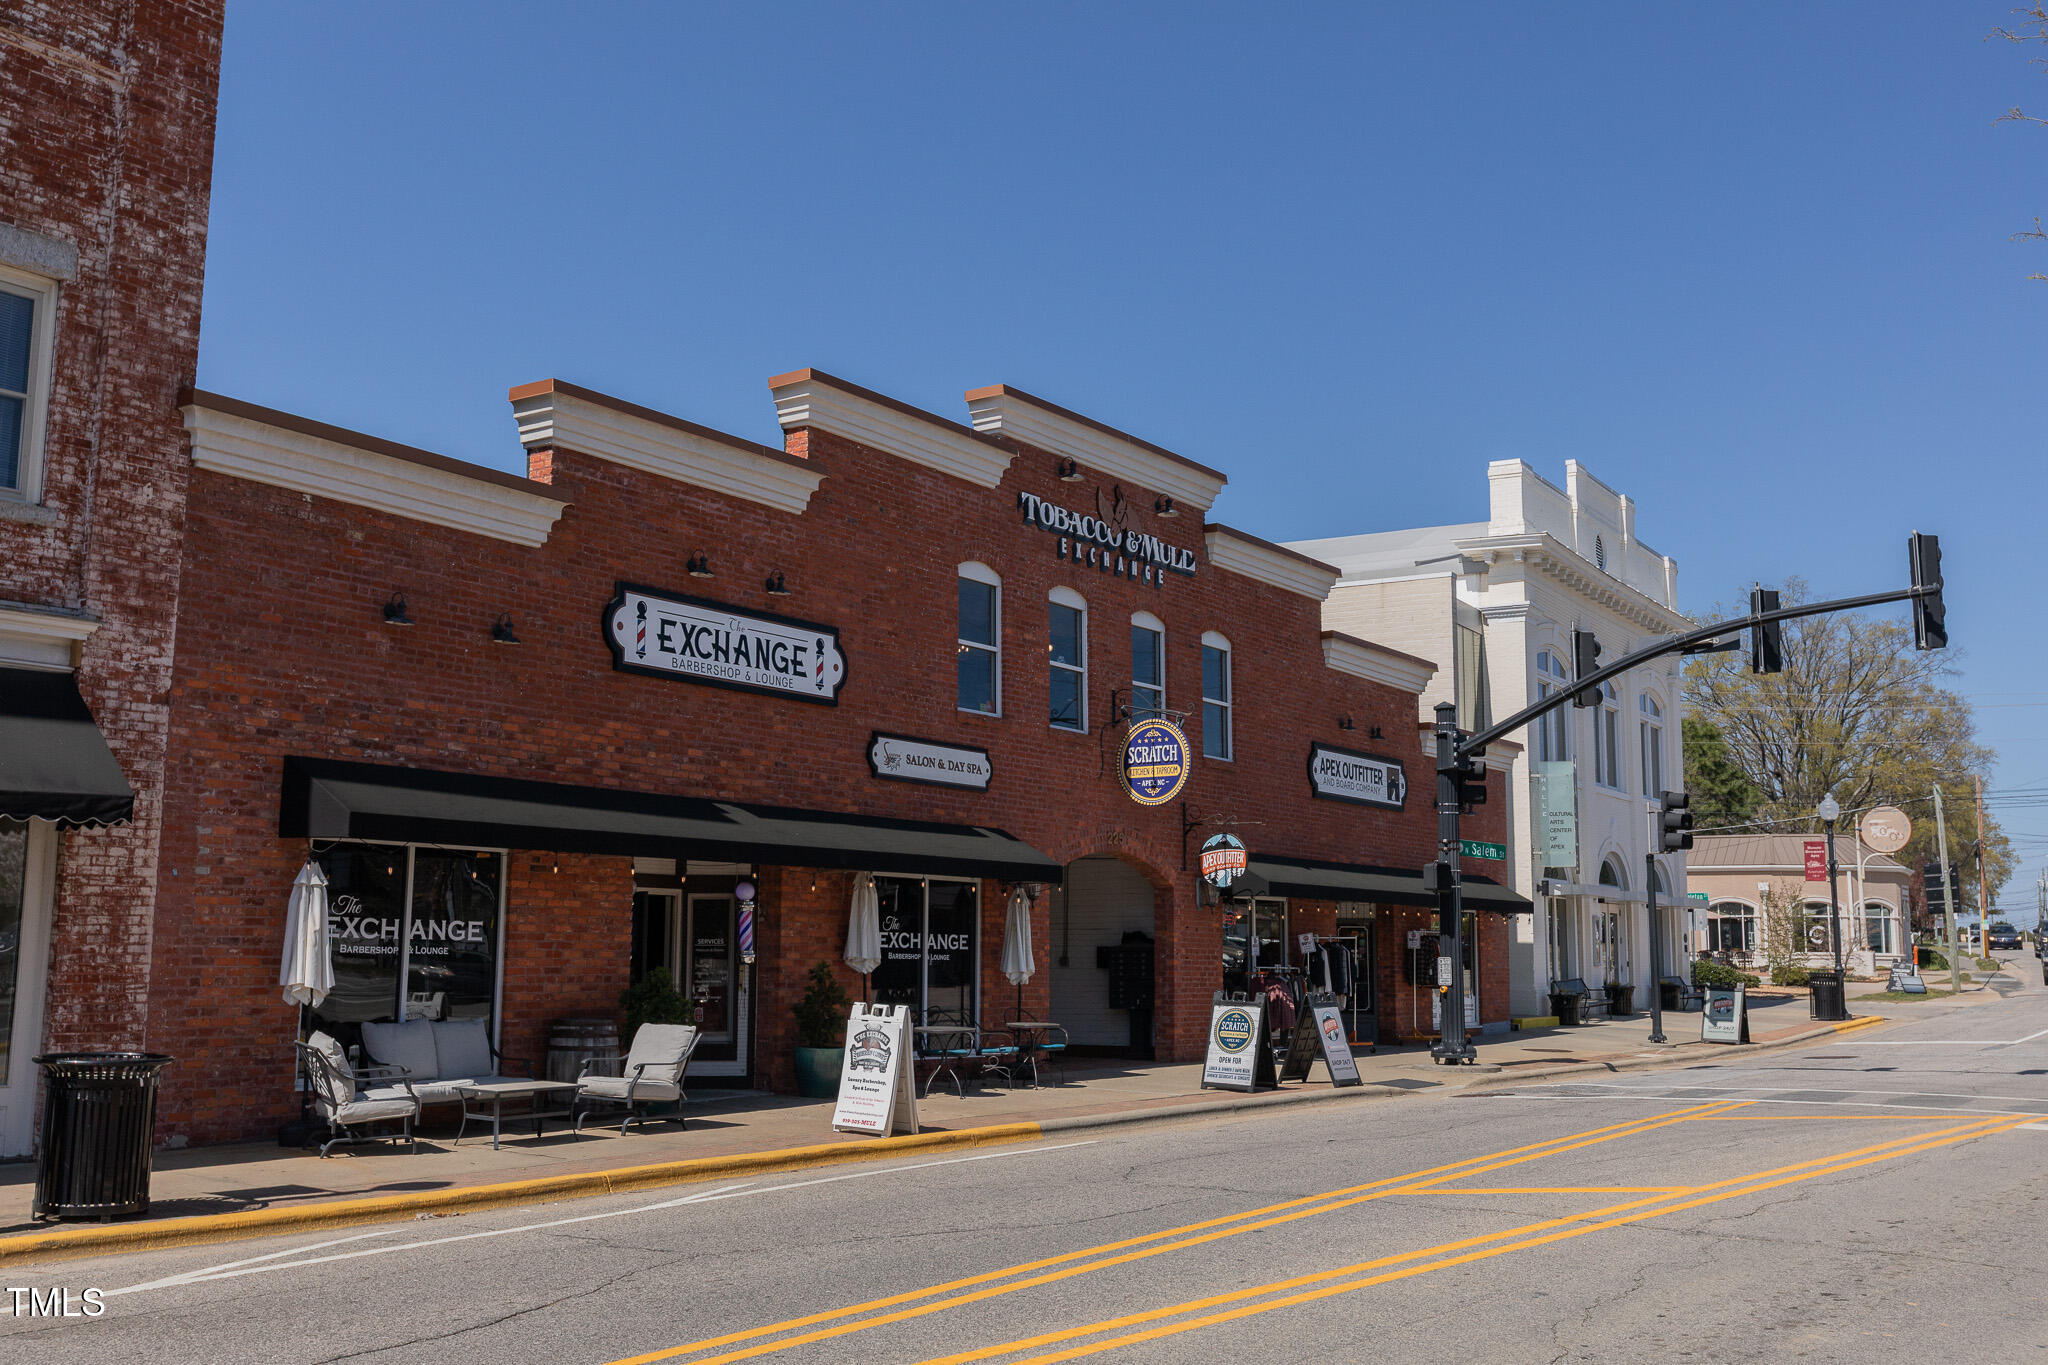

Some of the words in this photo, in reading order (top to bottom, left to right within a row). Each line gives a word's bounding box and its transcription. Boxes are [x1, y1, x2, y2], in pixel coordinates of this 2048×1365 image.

[1019, 491, 1122, 548] TOBACCO
[1126, 530, 1142, 552] &
[1141, 534, 1196, 572] MULE
[1058, 537, 1164, 584] EXCHANGE
[728, 617, 746, 633] The
[656, 618, 808, 678] EXCHANGE
[672, 657, 740, 679] BARBERSHOP
[744, 671, 752, 681] &
[756, 673, 794, 689] LOUNGE
[1128, 744, 1178, 764] SCRATCH
[906, 754, 936, 768] SALON
[938, 759, 946, 770] &
[948, 760, 965, 772] DAY
[967, 764, 982, 775] SPA
[1320, 758, 1341, 778] APEX
[1342, 762, 1384, 785] OUTFITTER
[1323, 777, 1334, 787] AND
[1336, 779, 1354, 790] BOARD
[1356, 782, 1381, 796] COMPANY
[1472, 843, 1497, 858] Salem
[1202, 853, 1217, 870] APEX
[331, 894, 362, 916] The
[328, 916, 484, 942] EXCHANGE
[882, 916, 900, 931] The
[880, 932, 968, 950] EXCHANGE
[1222, 1022, 1248, 1032] SCRATCH
[1218, 1056, 1232, 1064] OPEN
